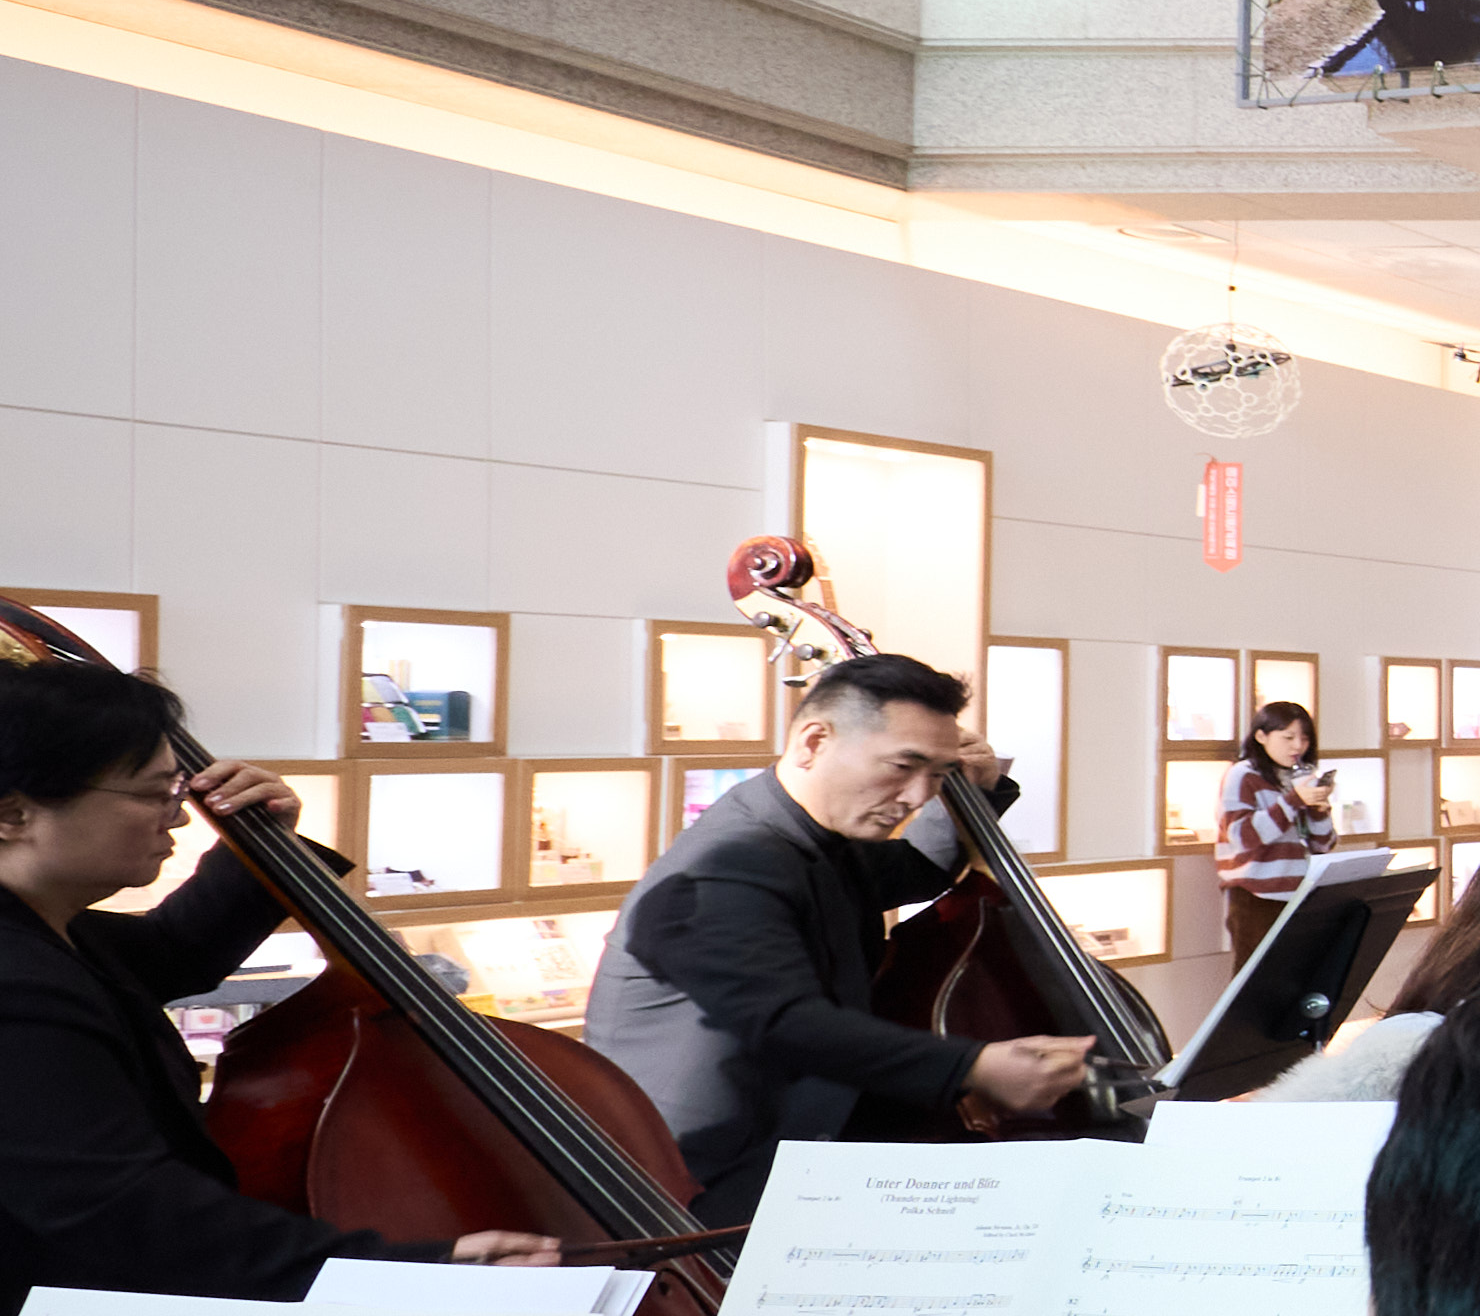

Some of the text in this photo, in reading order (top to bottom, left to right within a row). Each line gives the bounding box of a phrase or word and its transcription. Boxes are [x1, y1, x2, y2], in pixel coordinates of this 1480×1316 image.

[865, 1176, 1001, 1190] Unter Donner und Blitz
